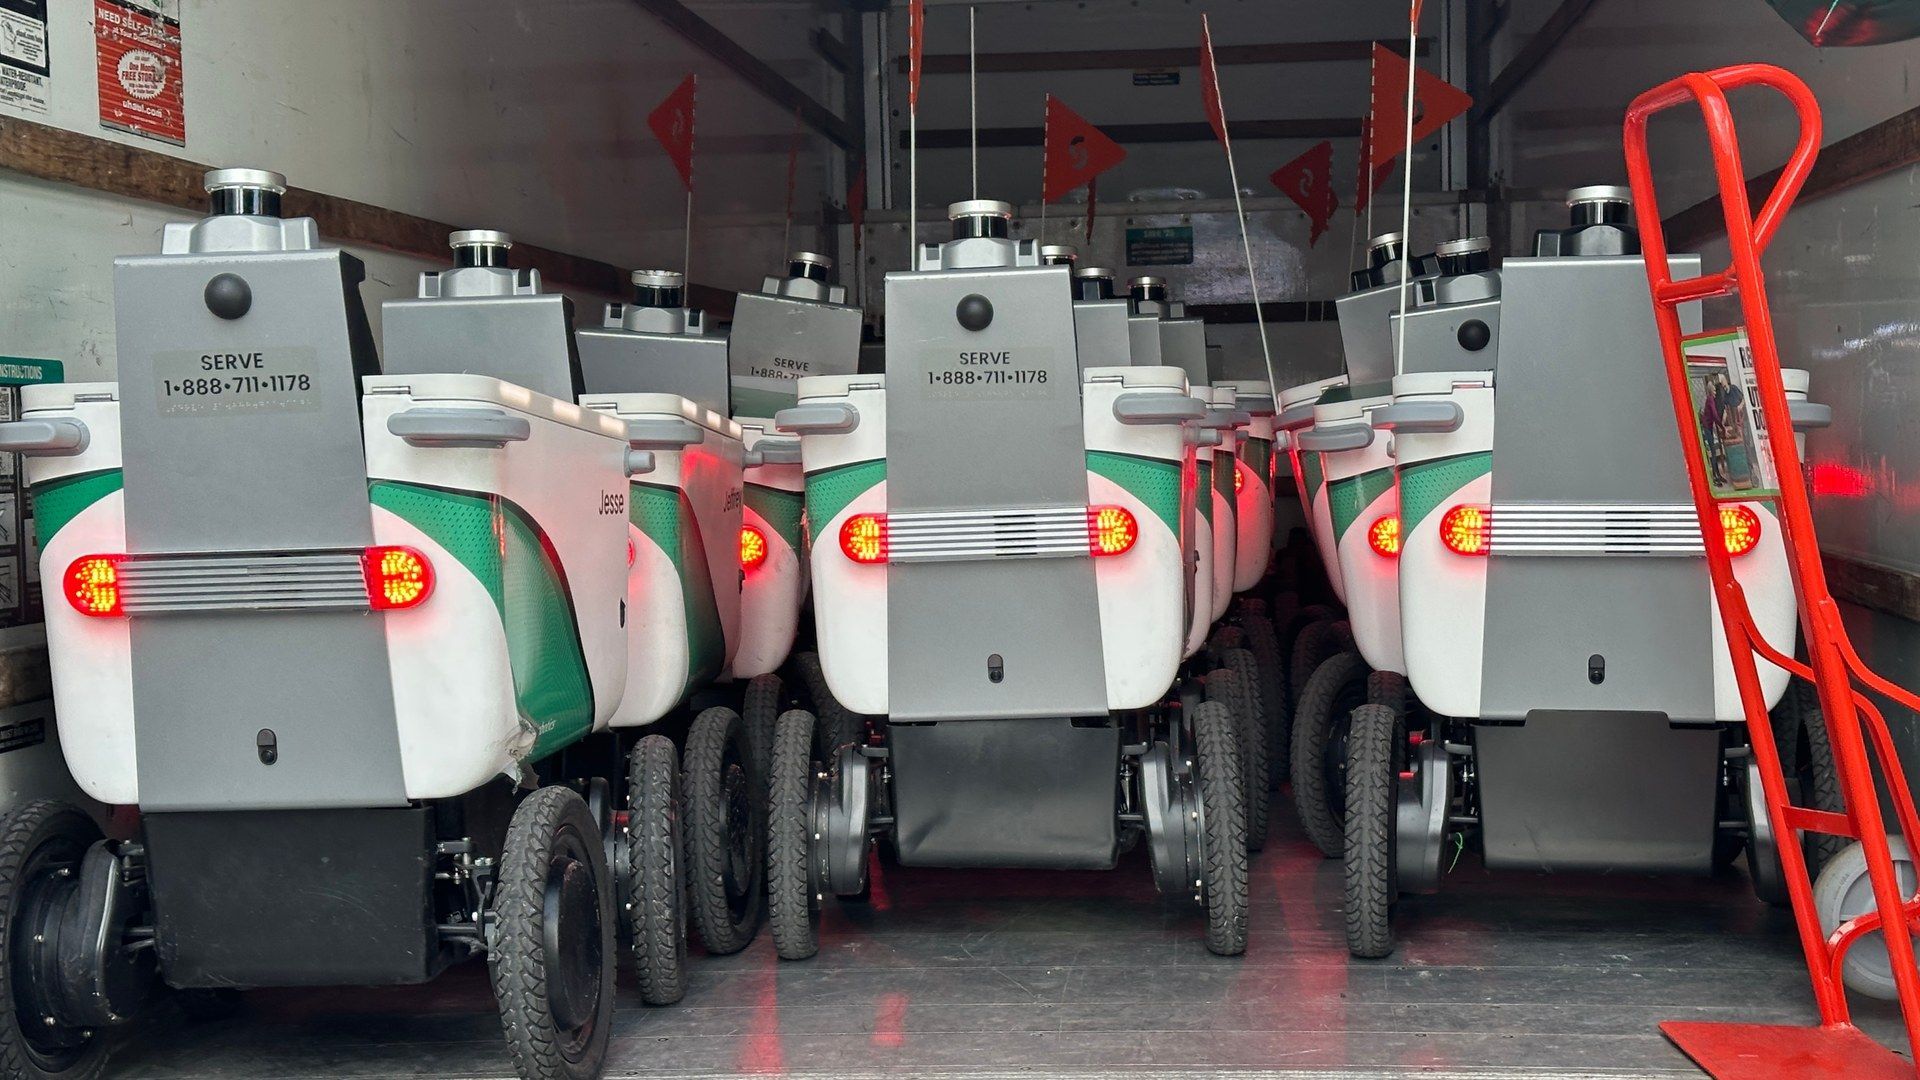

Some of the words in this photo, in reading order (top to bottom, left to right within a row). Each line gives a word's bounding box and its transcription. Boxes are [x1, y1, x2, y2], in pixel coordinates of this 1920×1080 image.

[98, 8, 120, 24] NEED
[121, 71, 136, 81] FREE
[122, 100, 162, 118] uhaul.com
[200, 352, 264, 371] SERVE
[774, 357, 810, 372] SERVE
[960, 351, 1010, 365] SERVE
[0, 363, 43, 380] NSTRUCTIONS
[598, 489, 624, 515] Jesse
